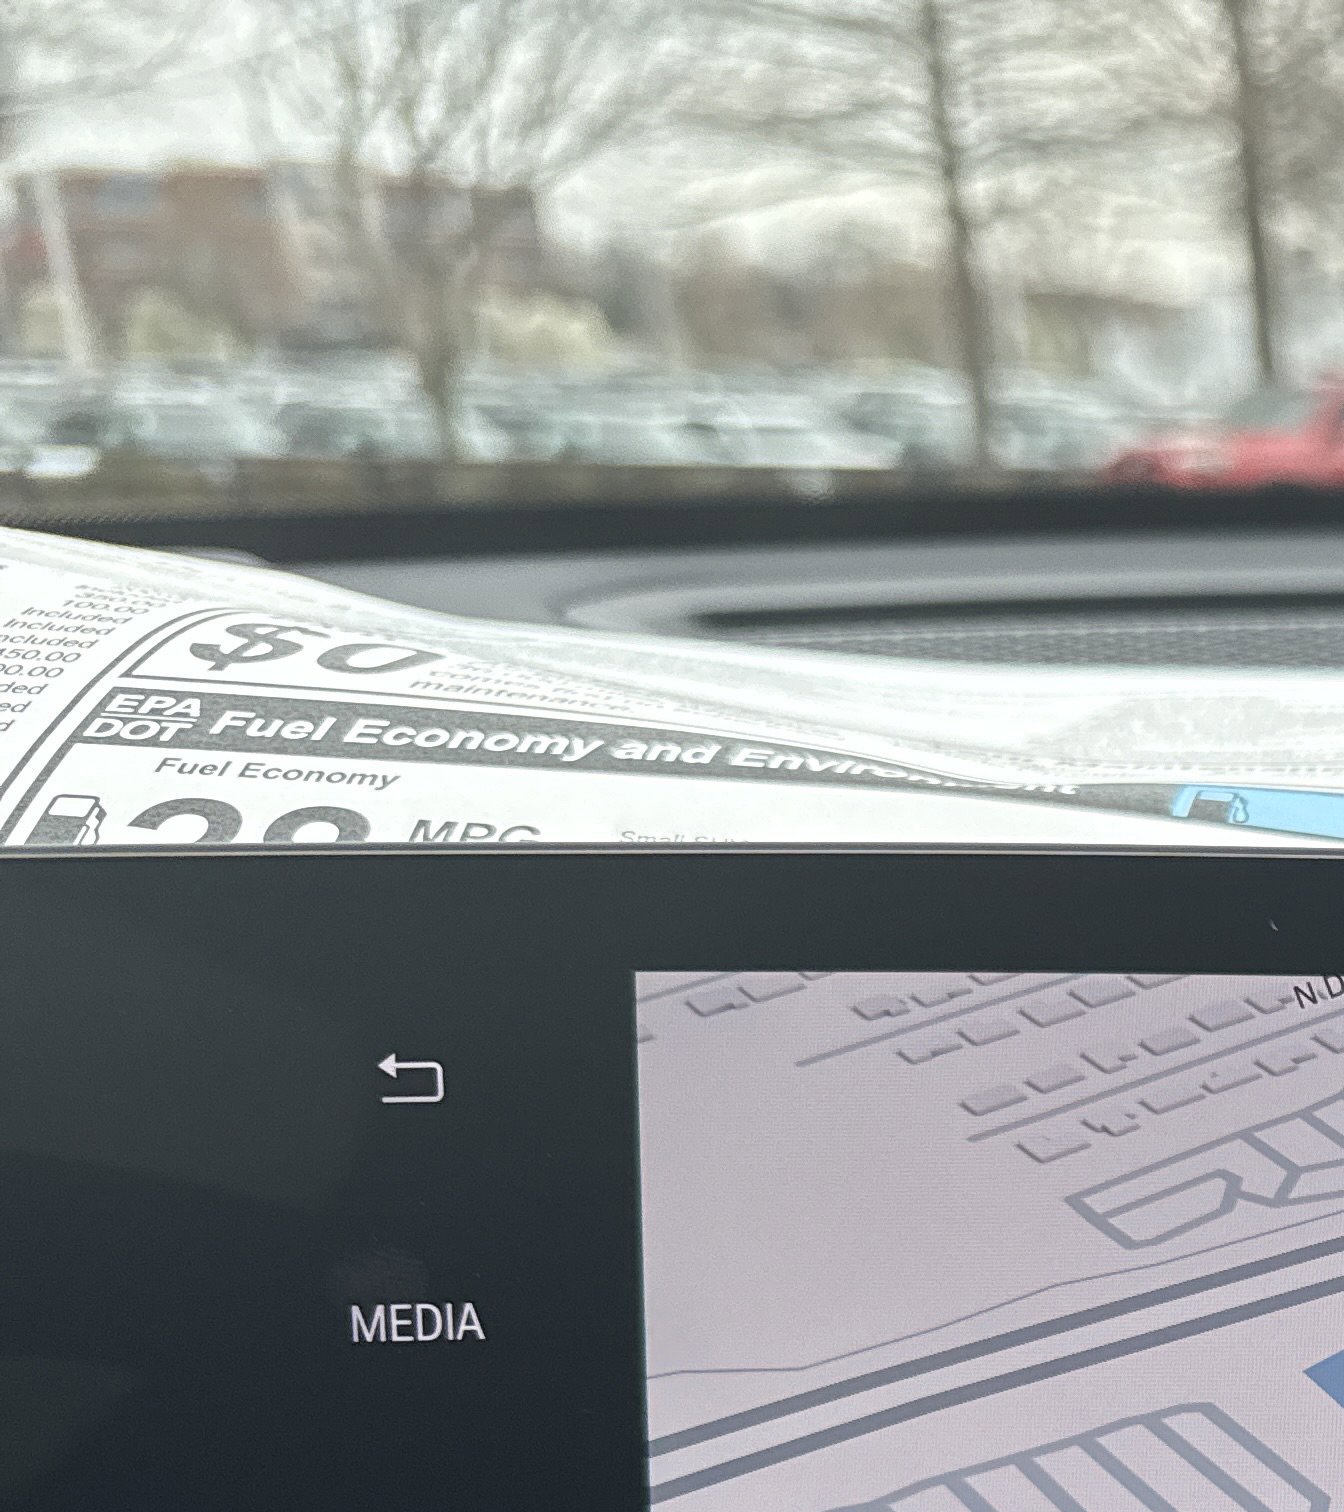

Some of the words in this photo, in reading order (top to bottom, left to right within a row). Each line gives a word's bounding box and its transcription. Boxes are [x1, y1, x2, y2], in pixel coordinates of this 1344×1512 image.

[3, 618, 116, 635] Included
[21, 606, 133, 624] Included
[105, 693, 200, 717] EPA
[83, 718, 194, 743] DOT
[209, 711, 336, 741] Fuel
[343, 718, 606, 762] Economy
[611, 740, 721, 764] and
[154, 757, 232, 777] Fuel
[238, 761, 401, 791] Economy
[1293, 981, 1318, 1009] N
[351, 1302, 487, 1342] MEDIA
